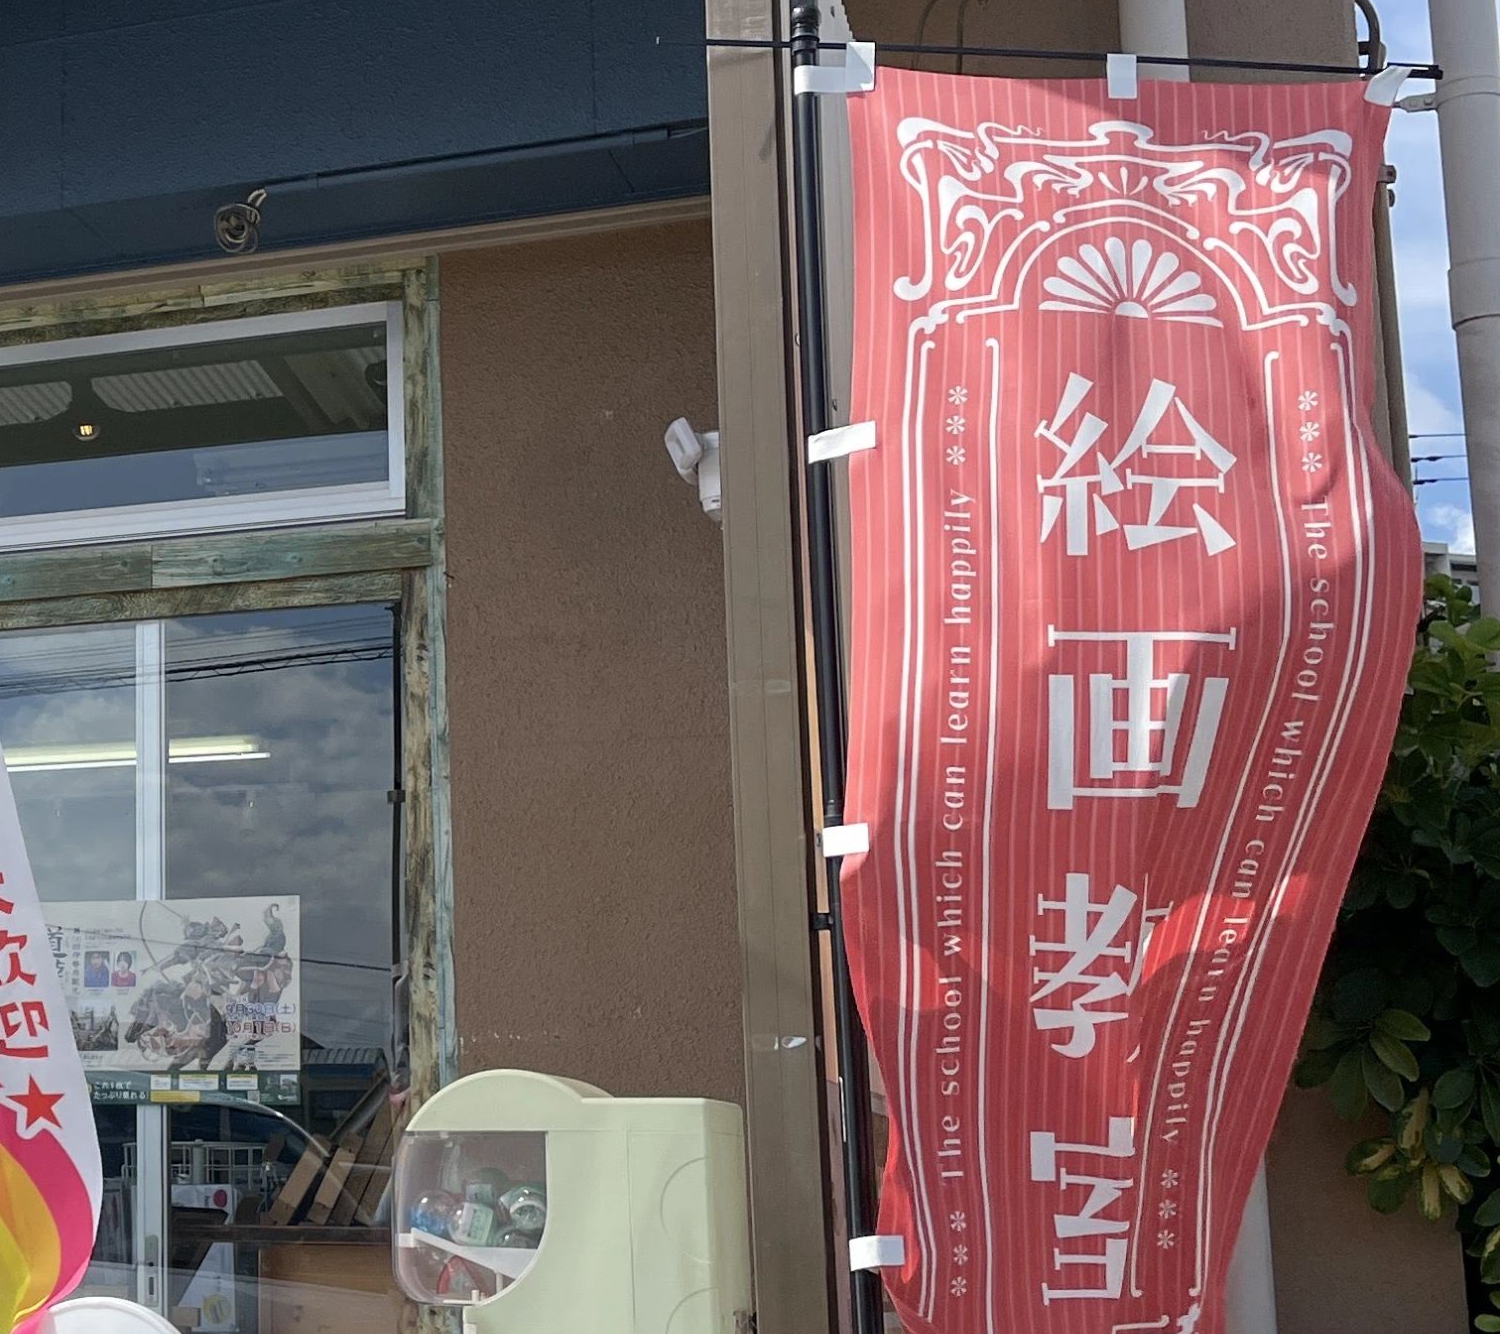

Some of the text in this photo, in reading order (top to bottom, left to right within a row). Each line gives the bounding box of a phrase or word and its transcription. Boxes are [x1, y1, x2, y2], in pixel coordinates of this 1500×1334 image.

[934, 488, 976, 1180] The school which can learn happily
[1160, 495, 1335, 1143] The school which can learn happily
